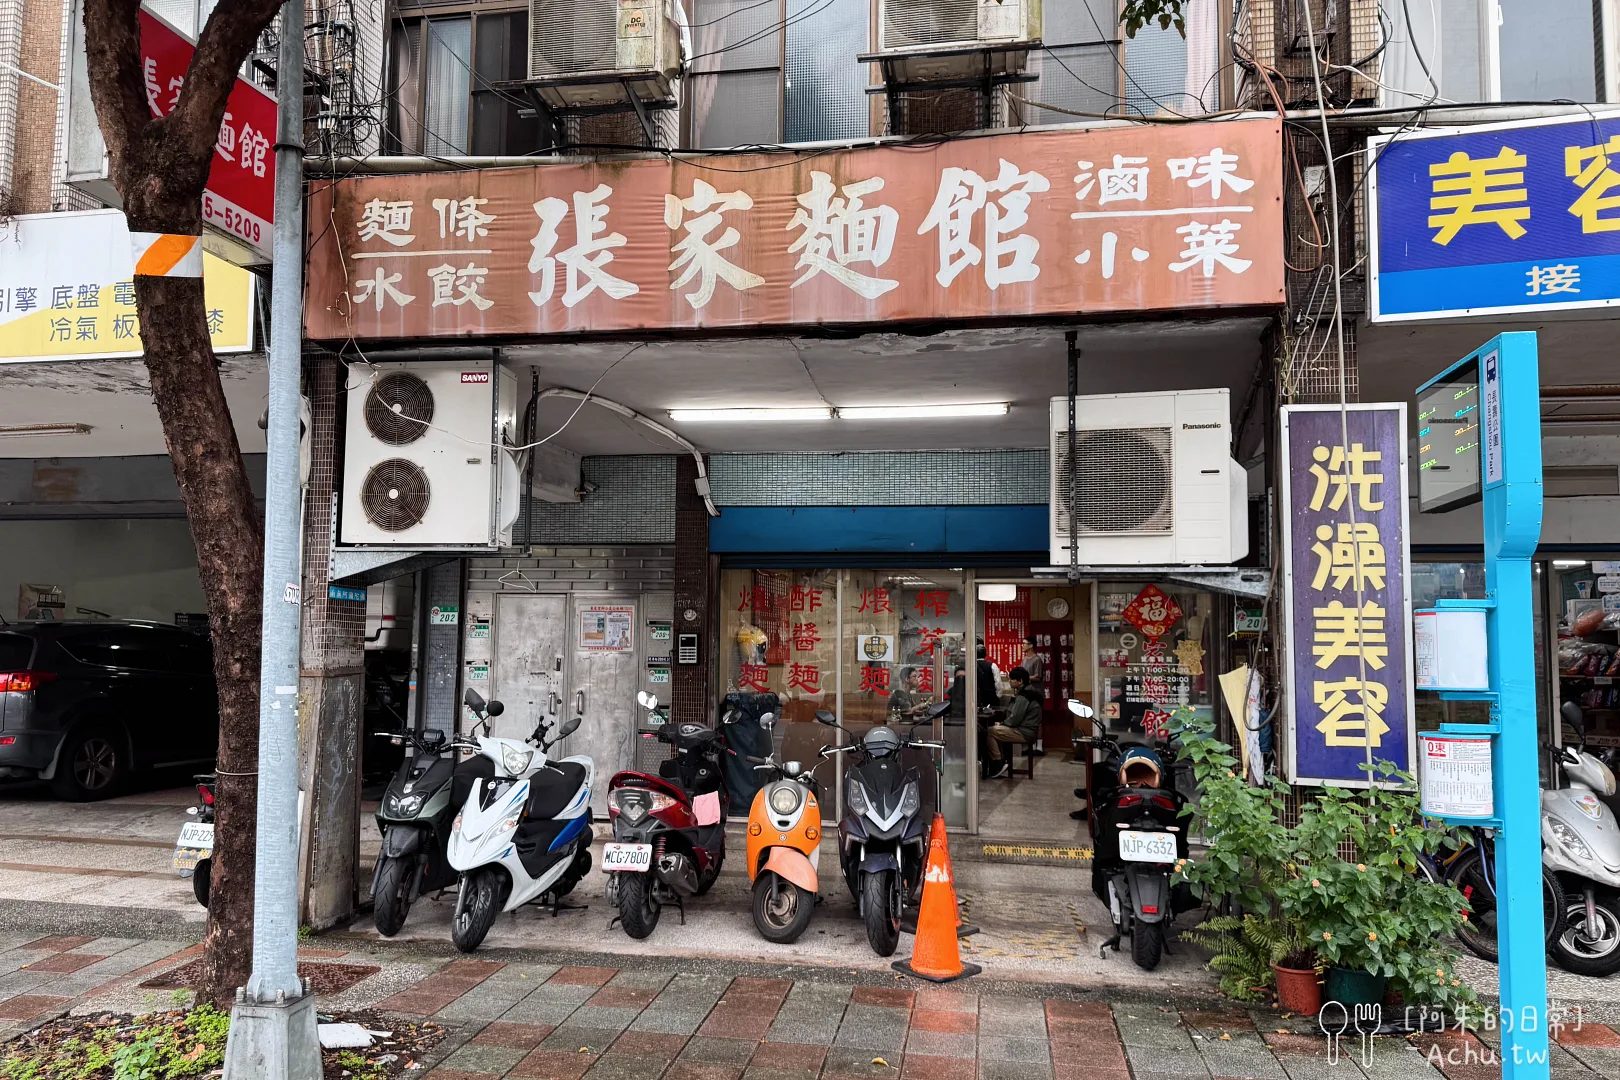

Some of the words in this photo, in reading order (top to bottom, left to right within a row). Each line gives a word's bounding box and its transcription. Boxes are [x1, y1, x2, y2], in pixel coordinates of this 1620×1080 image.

[1073, 147, 1254, 205] 滷味
[357, 197, 497, 246] 麵條
[527, 158, 1050, 309] 張家麵館
[1074, 218, 1253, 279] 小菜
[352, 261, 495, 311] 水餃
[1525, 264, 1581, 296] 接
[50, 283, 101, 310] 底盤
[49, 316, 99, 342] 冷氣
[461, 373, 489, 382] SANYO
[1182, 422, 1222, 430] Panasonic
[1138, 595, 1168, 622] 福
[1308, 442, 1391, 748] 洗澡美容
[439, 613, 456, 622] 202
[604, 850, 649, 864] MCG-7800
[1122, 838, 1174, 856] NJP-6332
